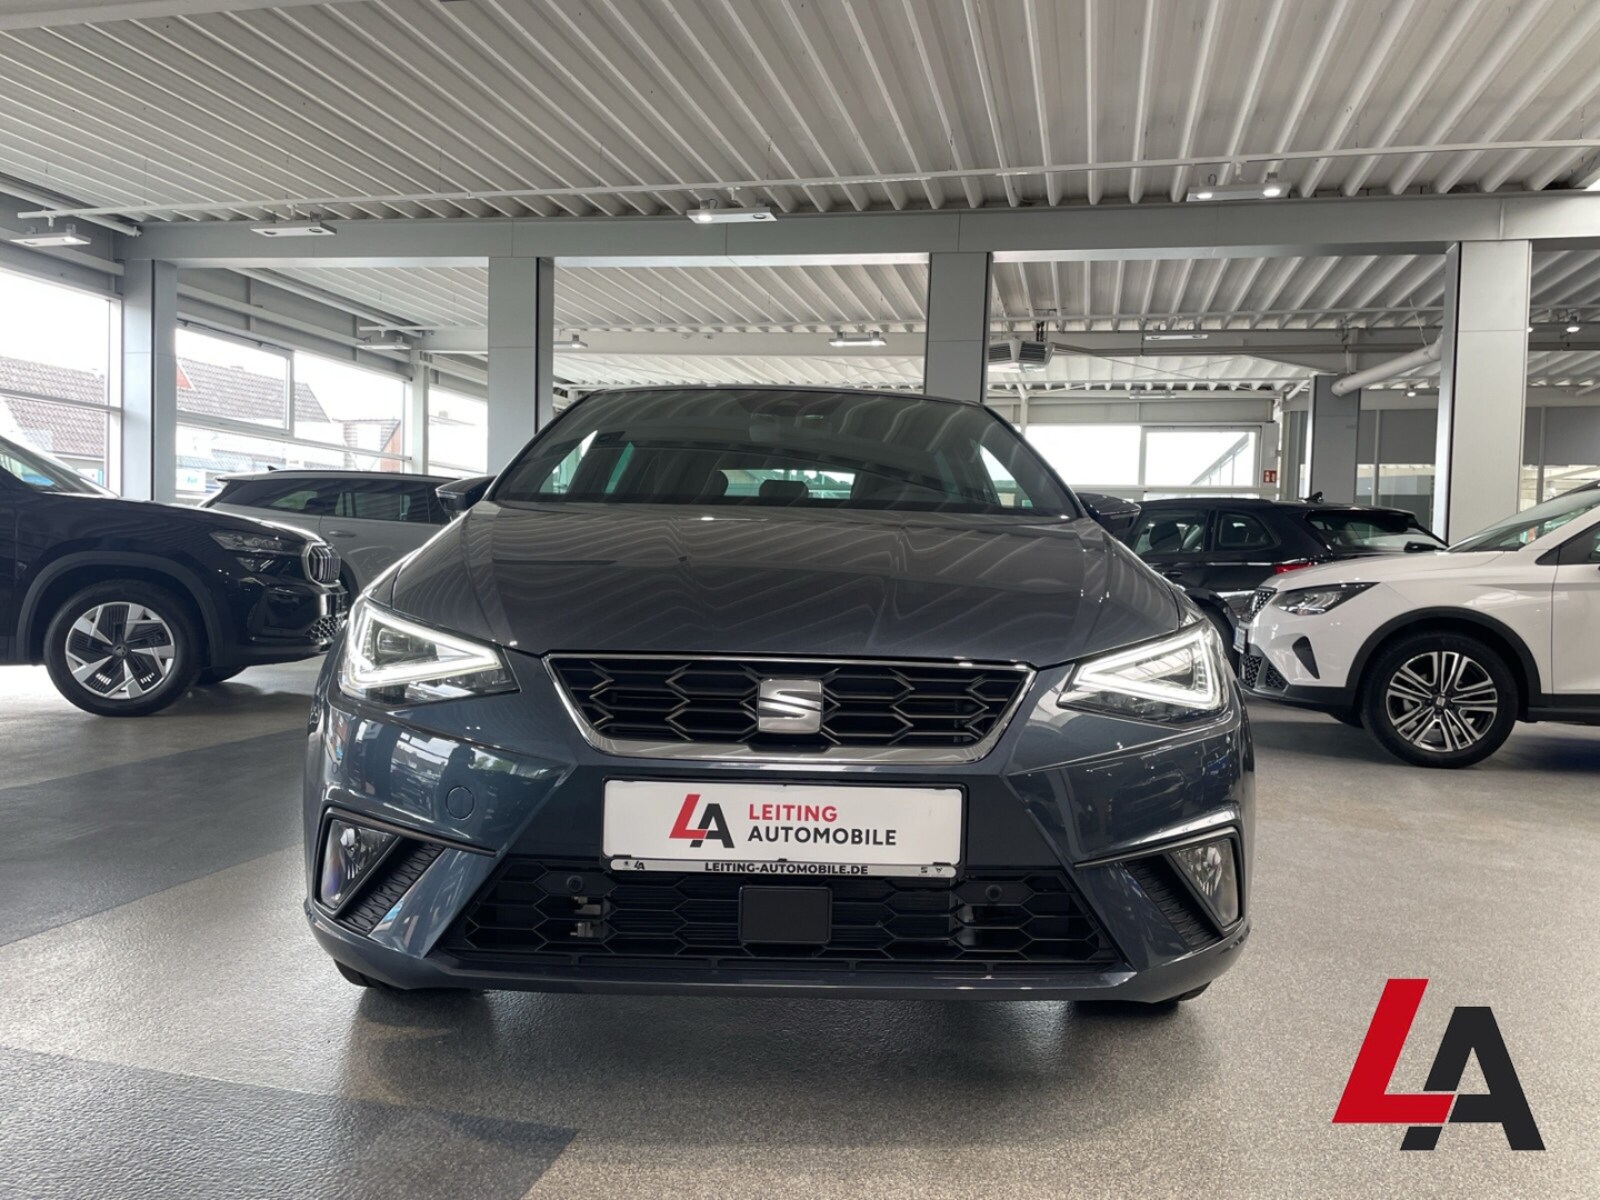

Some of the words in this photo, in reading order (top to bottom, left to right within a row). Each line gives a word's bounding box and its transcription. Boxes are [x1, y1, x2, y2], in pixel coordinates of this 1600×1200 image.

[748, 803, 838, 822] LEITING
[747, 825, 897, 846] AUTOMOBILE
[704, 862, 869, 875] LEITING-AUTOMOBILE.DE
